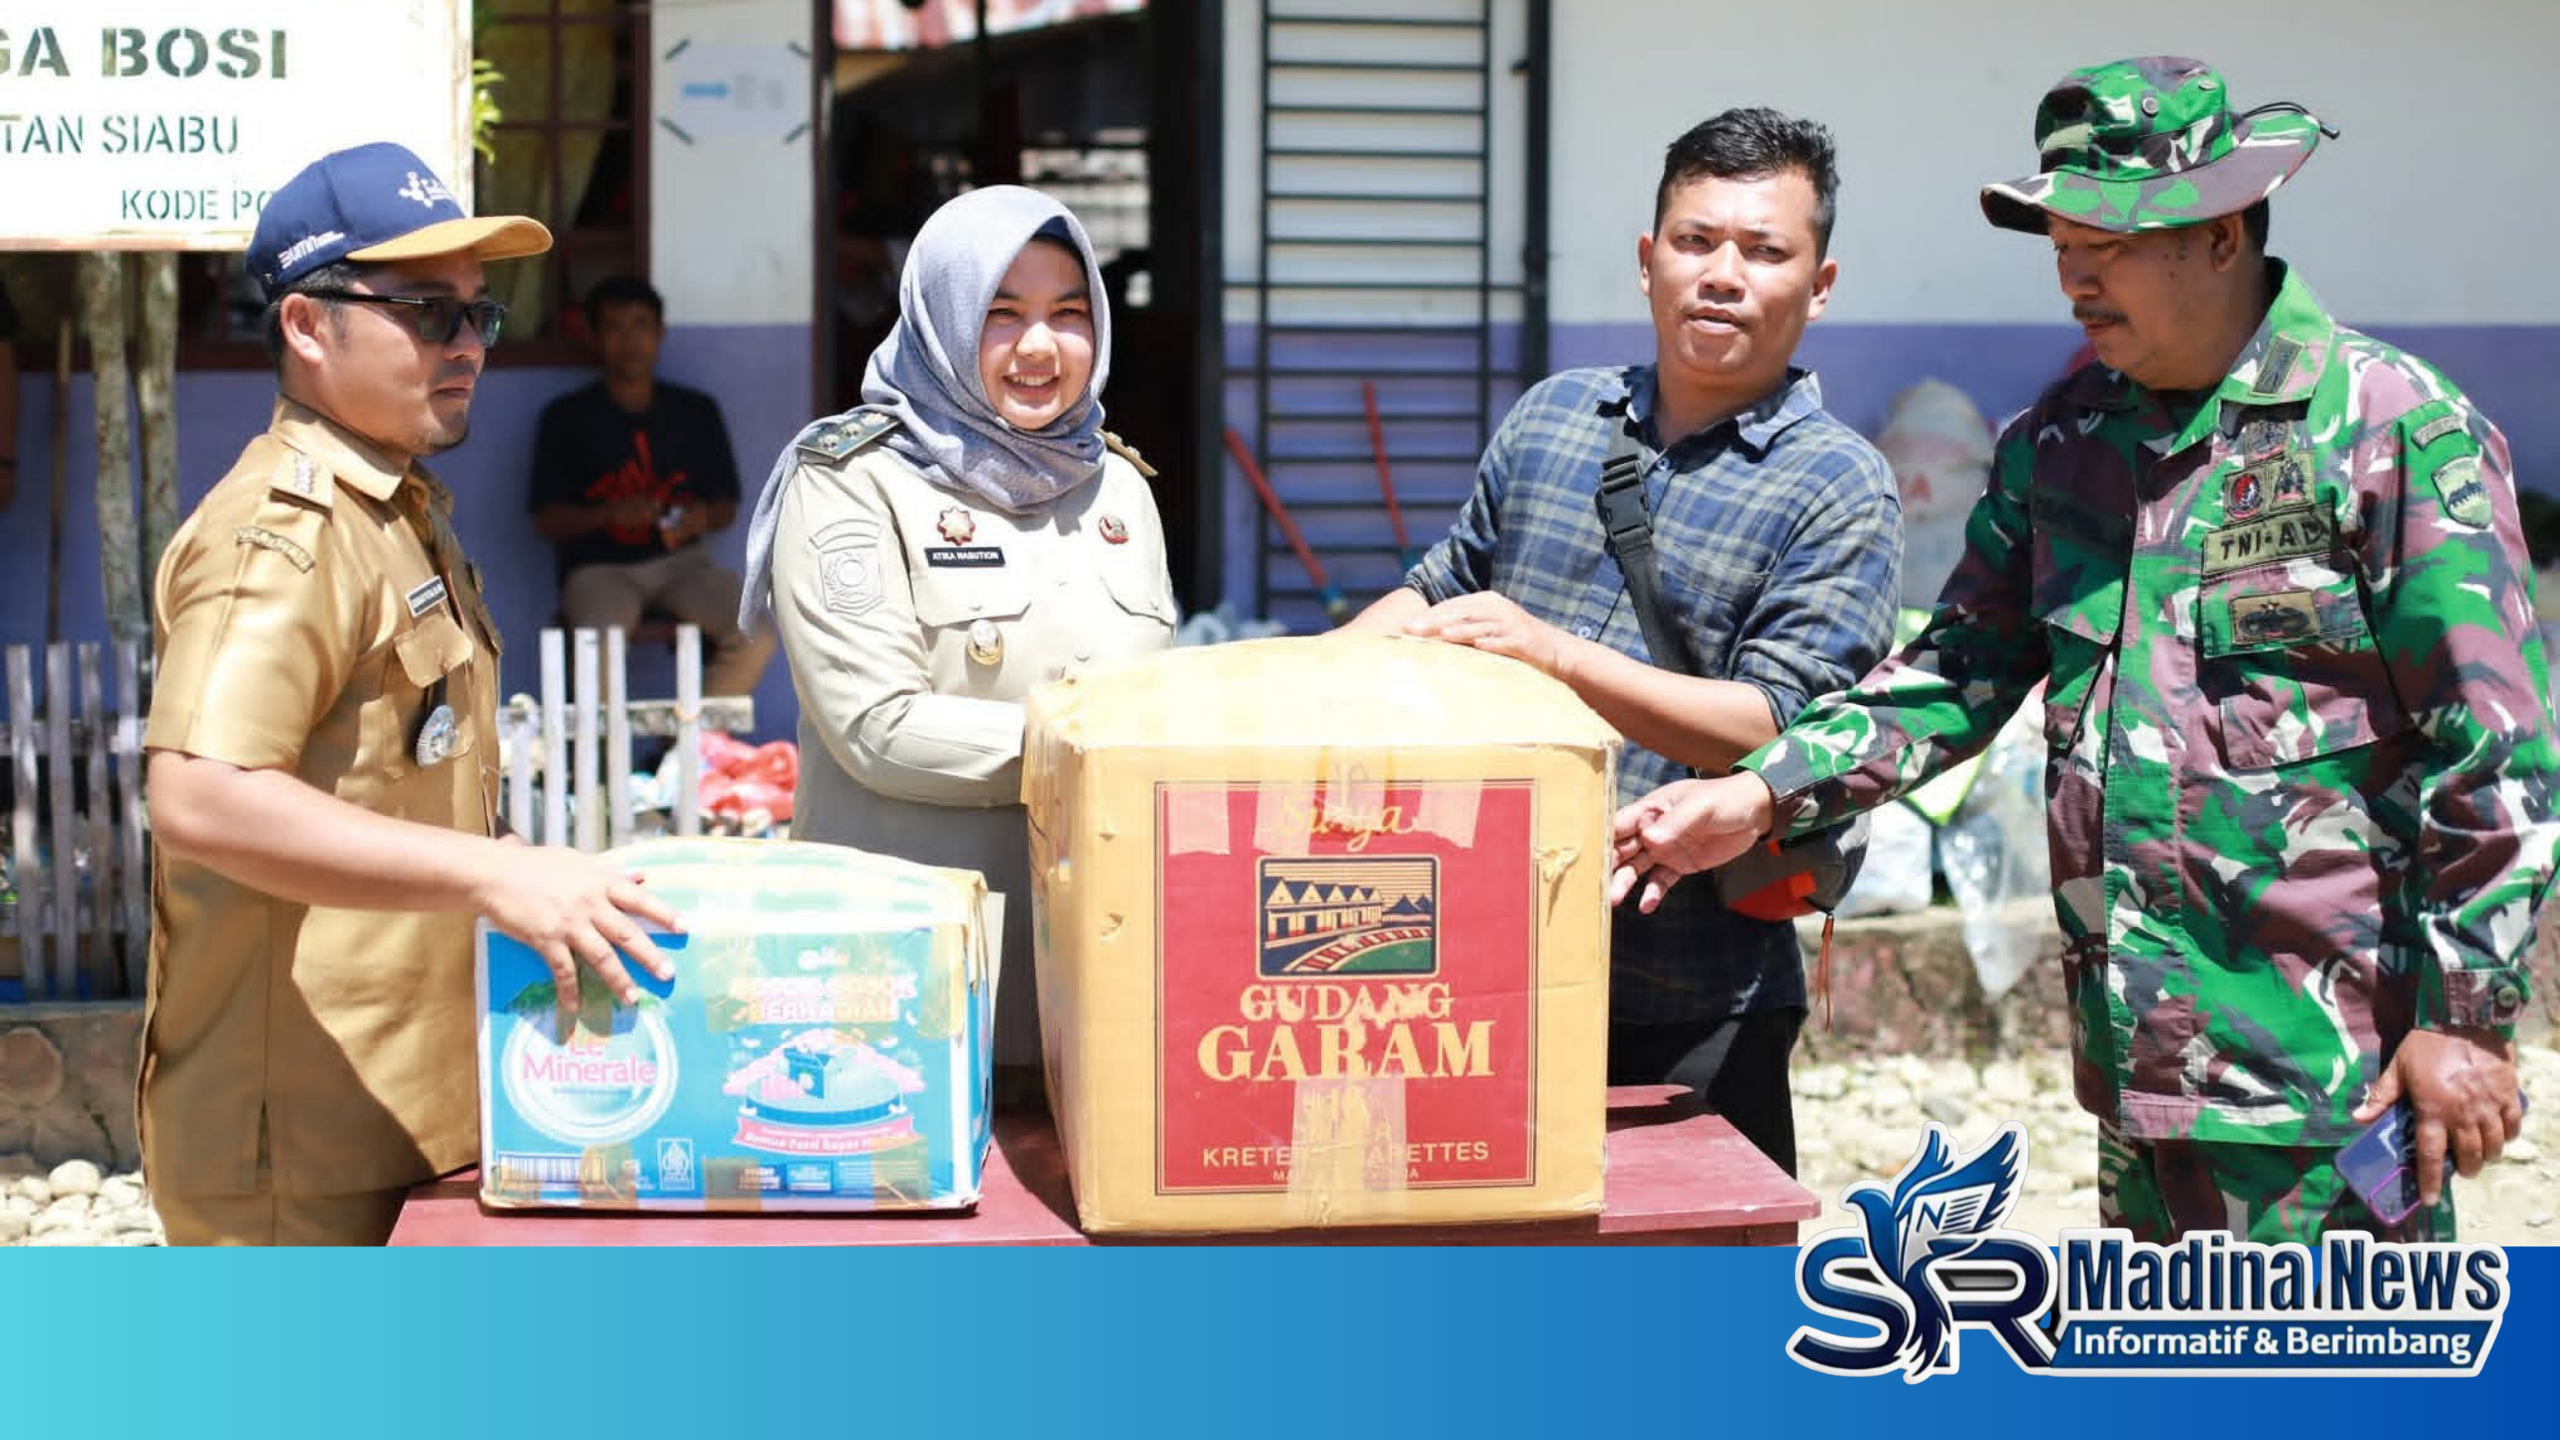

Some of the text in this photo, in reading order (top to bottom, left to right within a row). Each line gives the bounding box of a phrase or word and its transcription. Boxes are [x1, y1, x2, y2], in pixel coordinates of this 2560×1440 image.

[0, 26, 287, 80] A BOSI
[102, 115, 238, 153] SIABU
[121, 189, 219, 220] KODE
[1239, 982, 1456, 1024] GUDANG
[522, 1052, 658, 1084] Minerale
[1197, 1020, 1497, 1082] GARAM
[1202, 1145, 1301, 1169] KRETE
